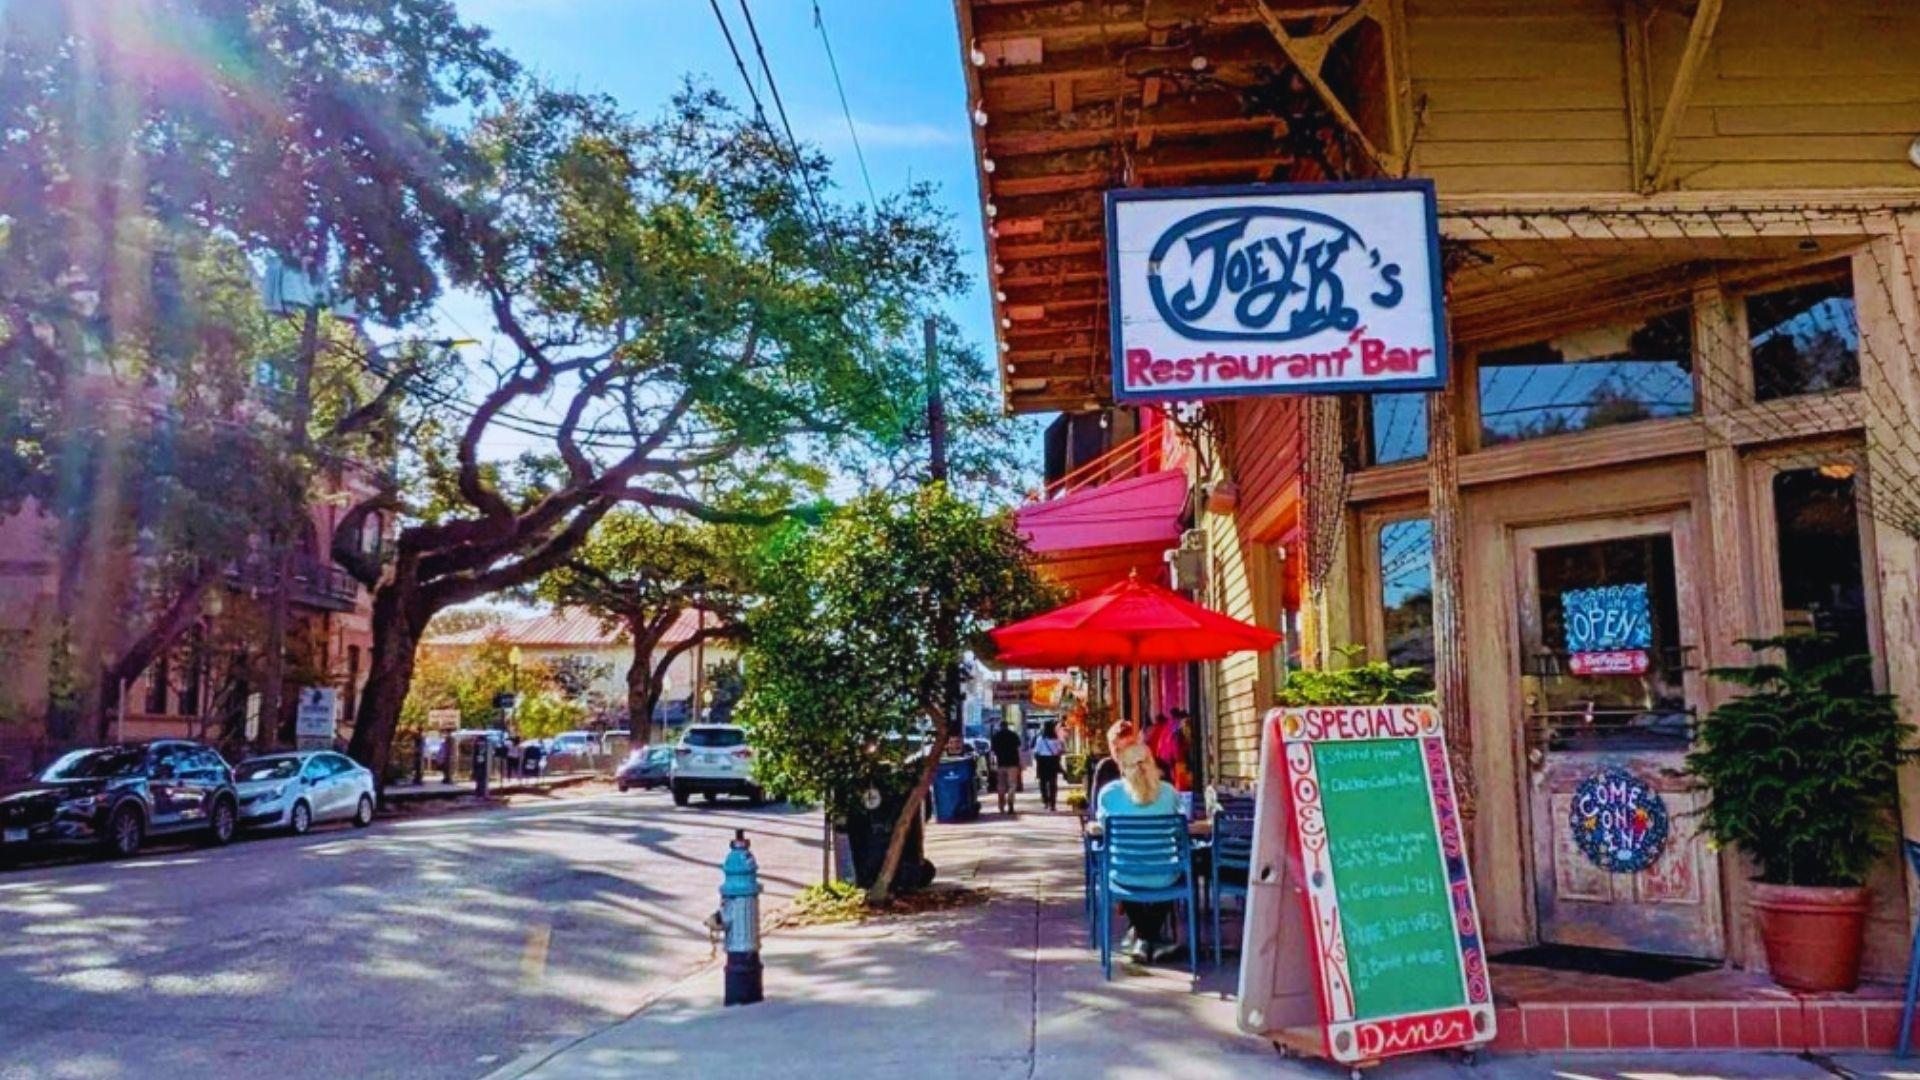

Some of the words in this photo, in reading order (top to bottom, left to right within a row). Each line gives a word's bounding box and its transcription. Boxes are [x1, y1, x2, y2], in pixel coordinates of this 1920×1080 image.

[1126, 346, 1354, 387] Restaurant
[1361, 339, 1432, 375] Bar
[1573, 609, 1637, 641] OPEN
[1306, 707, 1419, 740] SPECIALS
[1580, 781, 1642, 817] COME
[1602, 808, 1627, 829] ON
[1451, 878, 1474, 936] TO
[1463, 948, 1490, 1002] GO
[1358, 1019, 1465, 1055] Diner
